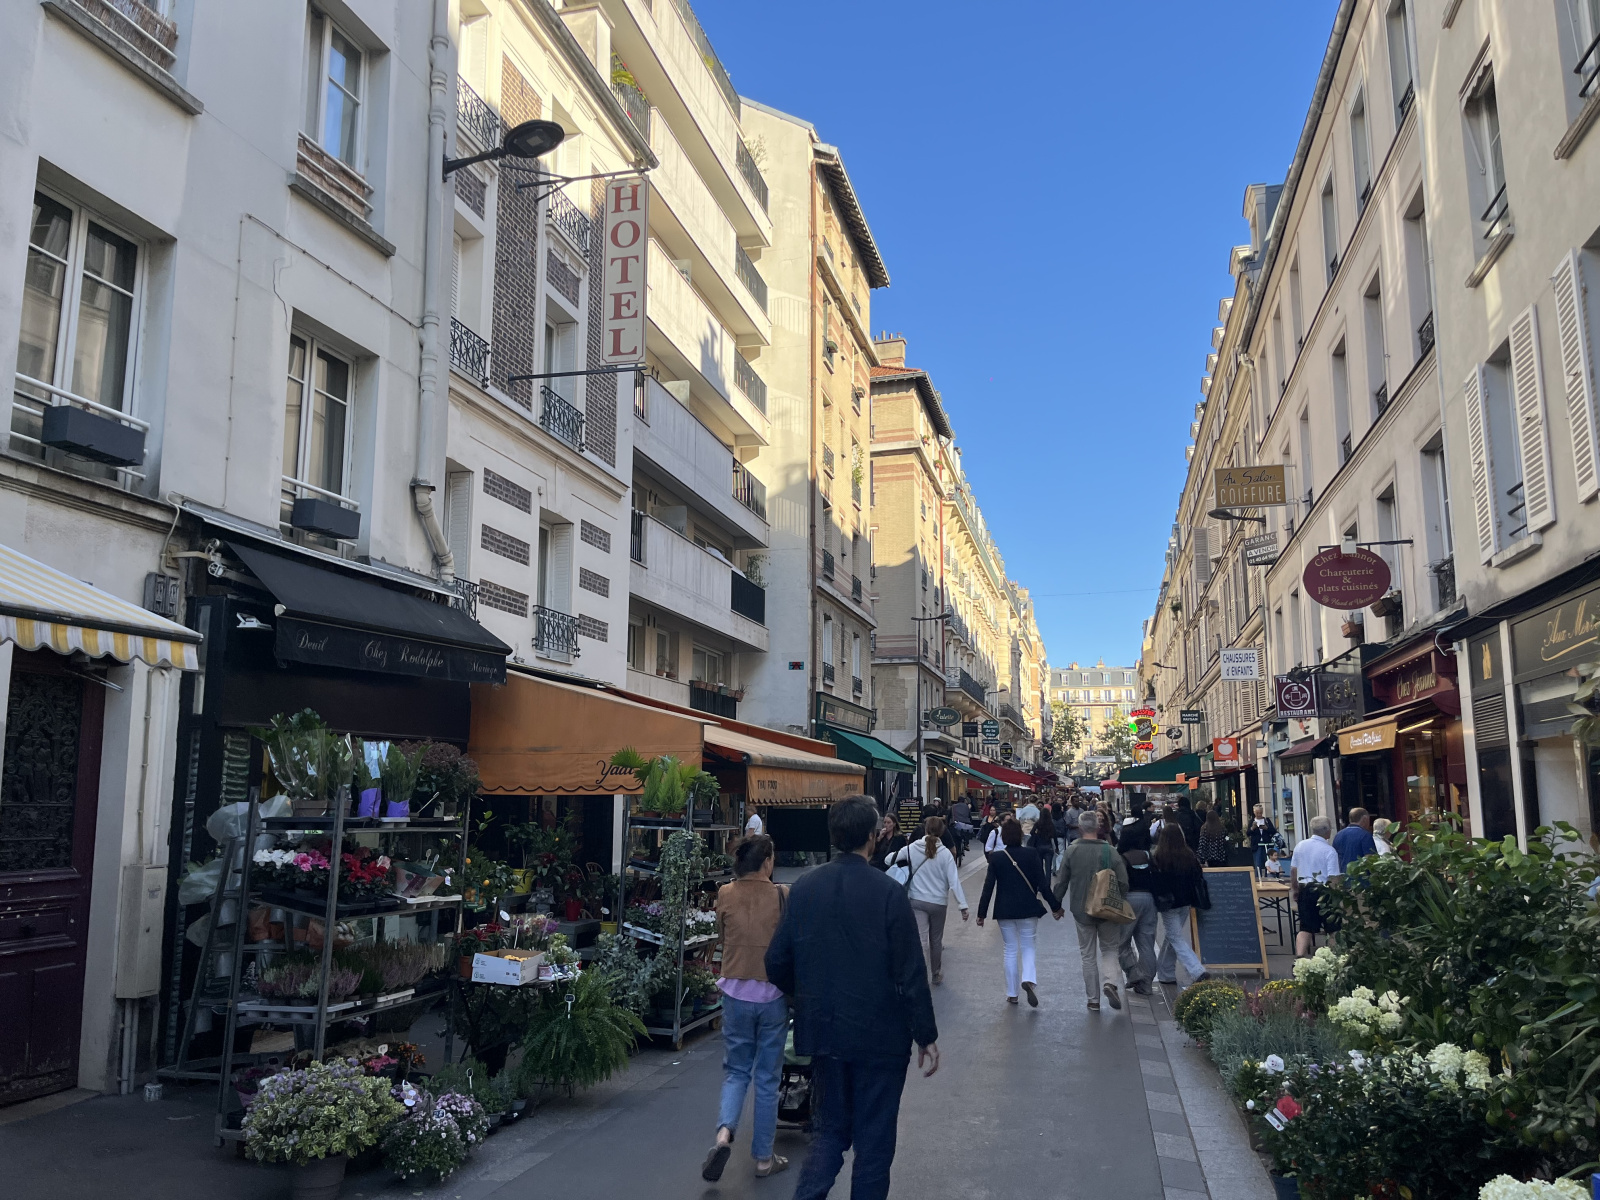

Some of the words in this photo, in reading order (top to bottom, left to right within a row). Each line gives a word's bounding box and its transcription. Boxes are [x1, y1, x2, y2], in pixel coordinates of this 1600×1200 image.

[608, 184, 642, 357] HOTEL
[1223, 472, 1236, 486] Au
[1220, 485, 1281, 505] COIFFURE
[1314, 552, 1338, 567] Chez
[1319, 567, 1375, 578] Charcuterie
[1342, 576, 1352, 584] &
[1318, 584, 1340, 595] plats
[1341, 582, 1379, 592] cuisinés
[297, 628, 328, 651] Deuil
[362, 639, 388, 667] Chez
[399, 642, 445, 674] Rodolphe
[1222, 652, 1256, 664] CHAUSSURES
[1279, 709, 1315, 717] RESTAURANT
